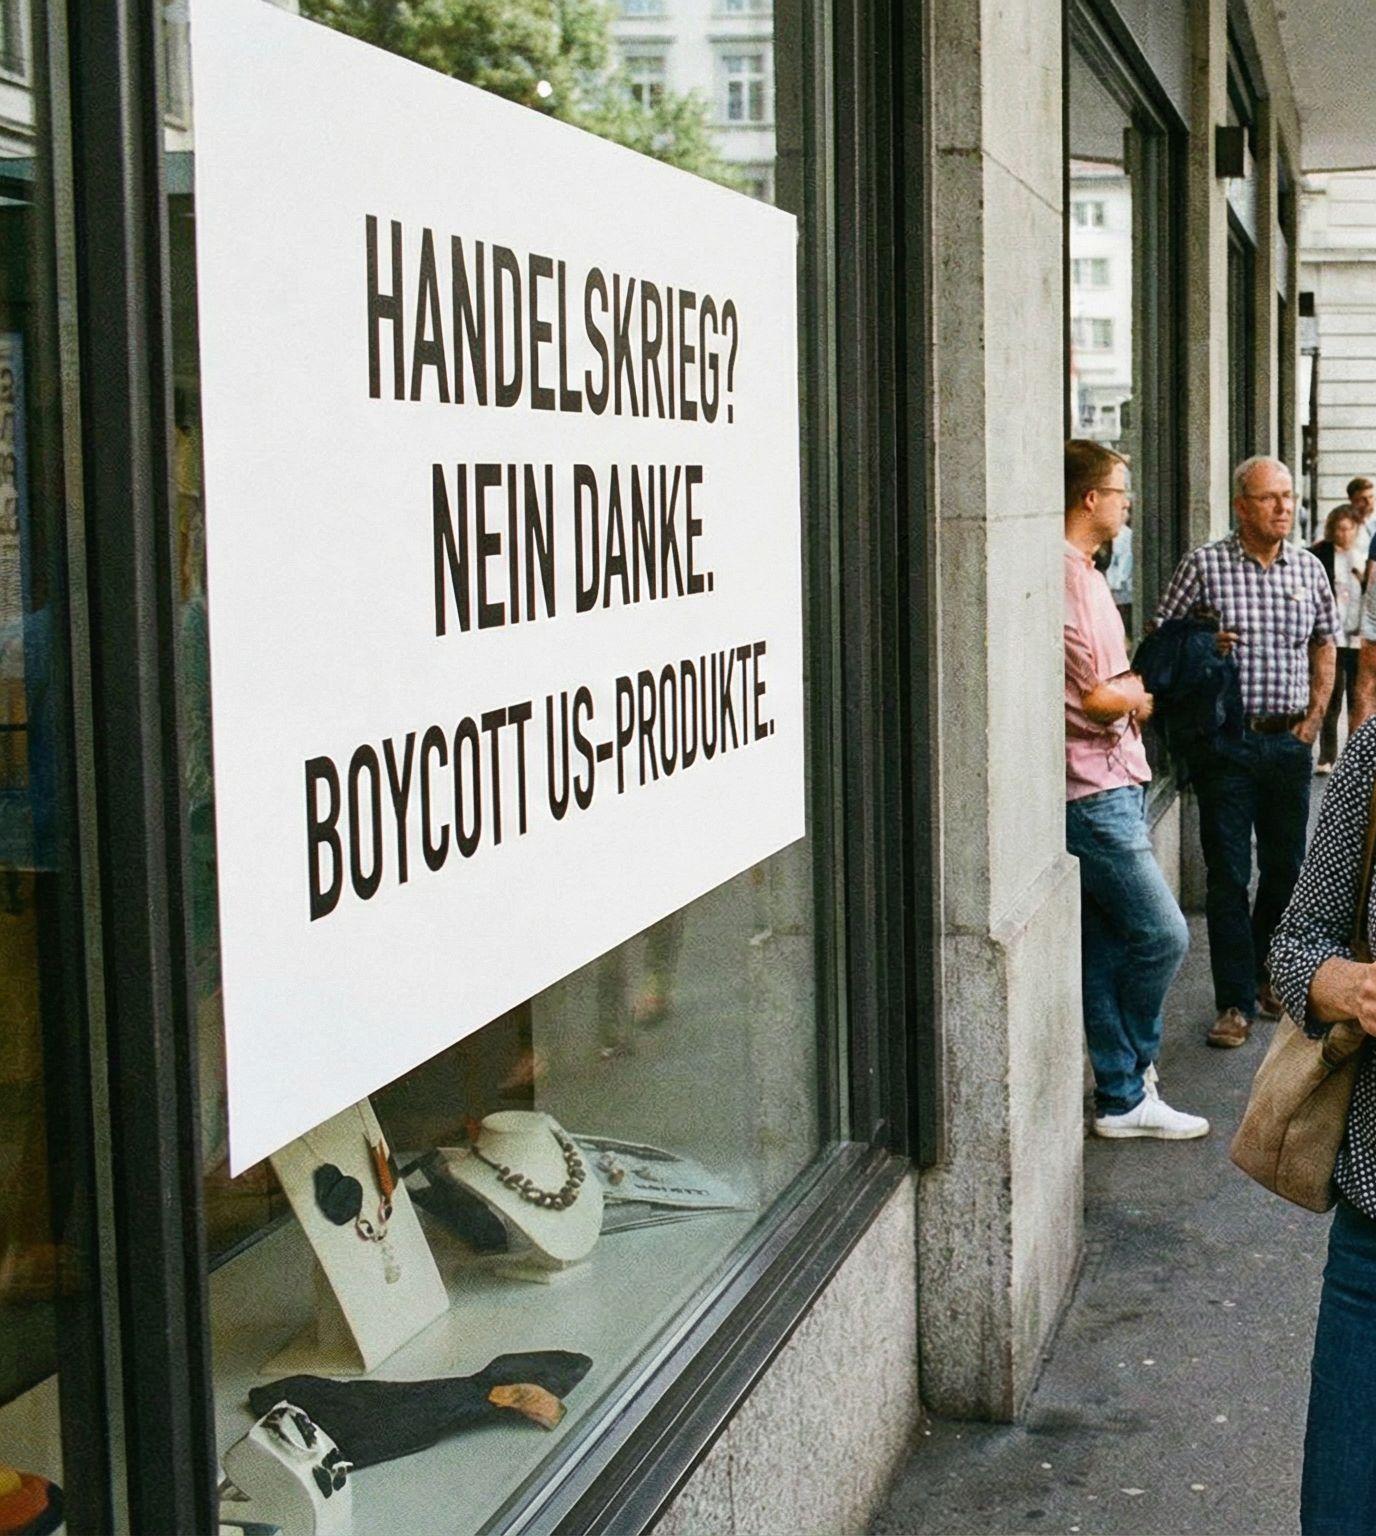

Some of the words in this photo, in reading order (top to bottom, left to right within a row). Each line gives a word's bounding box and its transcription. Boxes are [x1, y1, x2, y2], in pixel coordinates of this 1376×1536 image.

[365, 214, 738, 424] HANDELSKRIEG?
[432, 463, 556, 637] NEIN
[573, 464, 714, 614] DANKE.
[304, 700, 532, 922] BOYCOTT
[546, 640, 775, 821] US-PRODUKTE.
